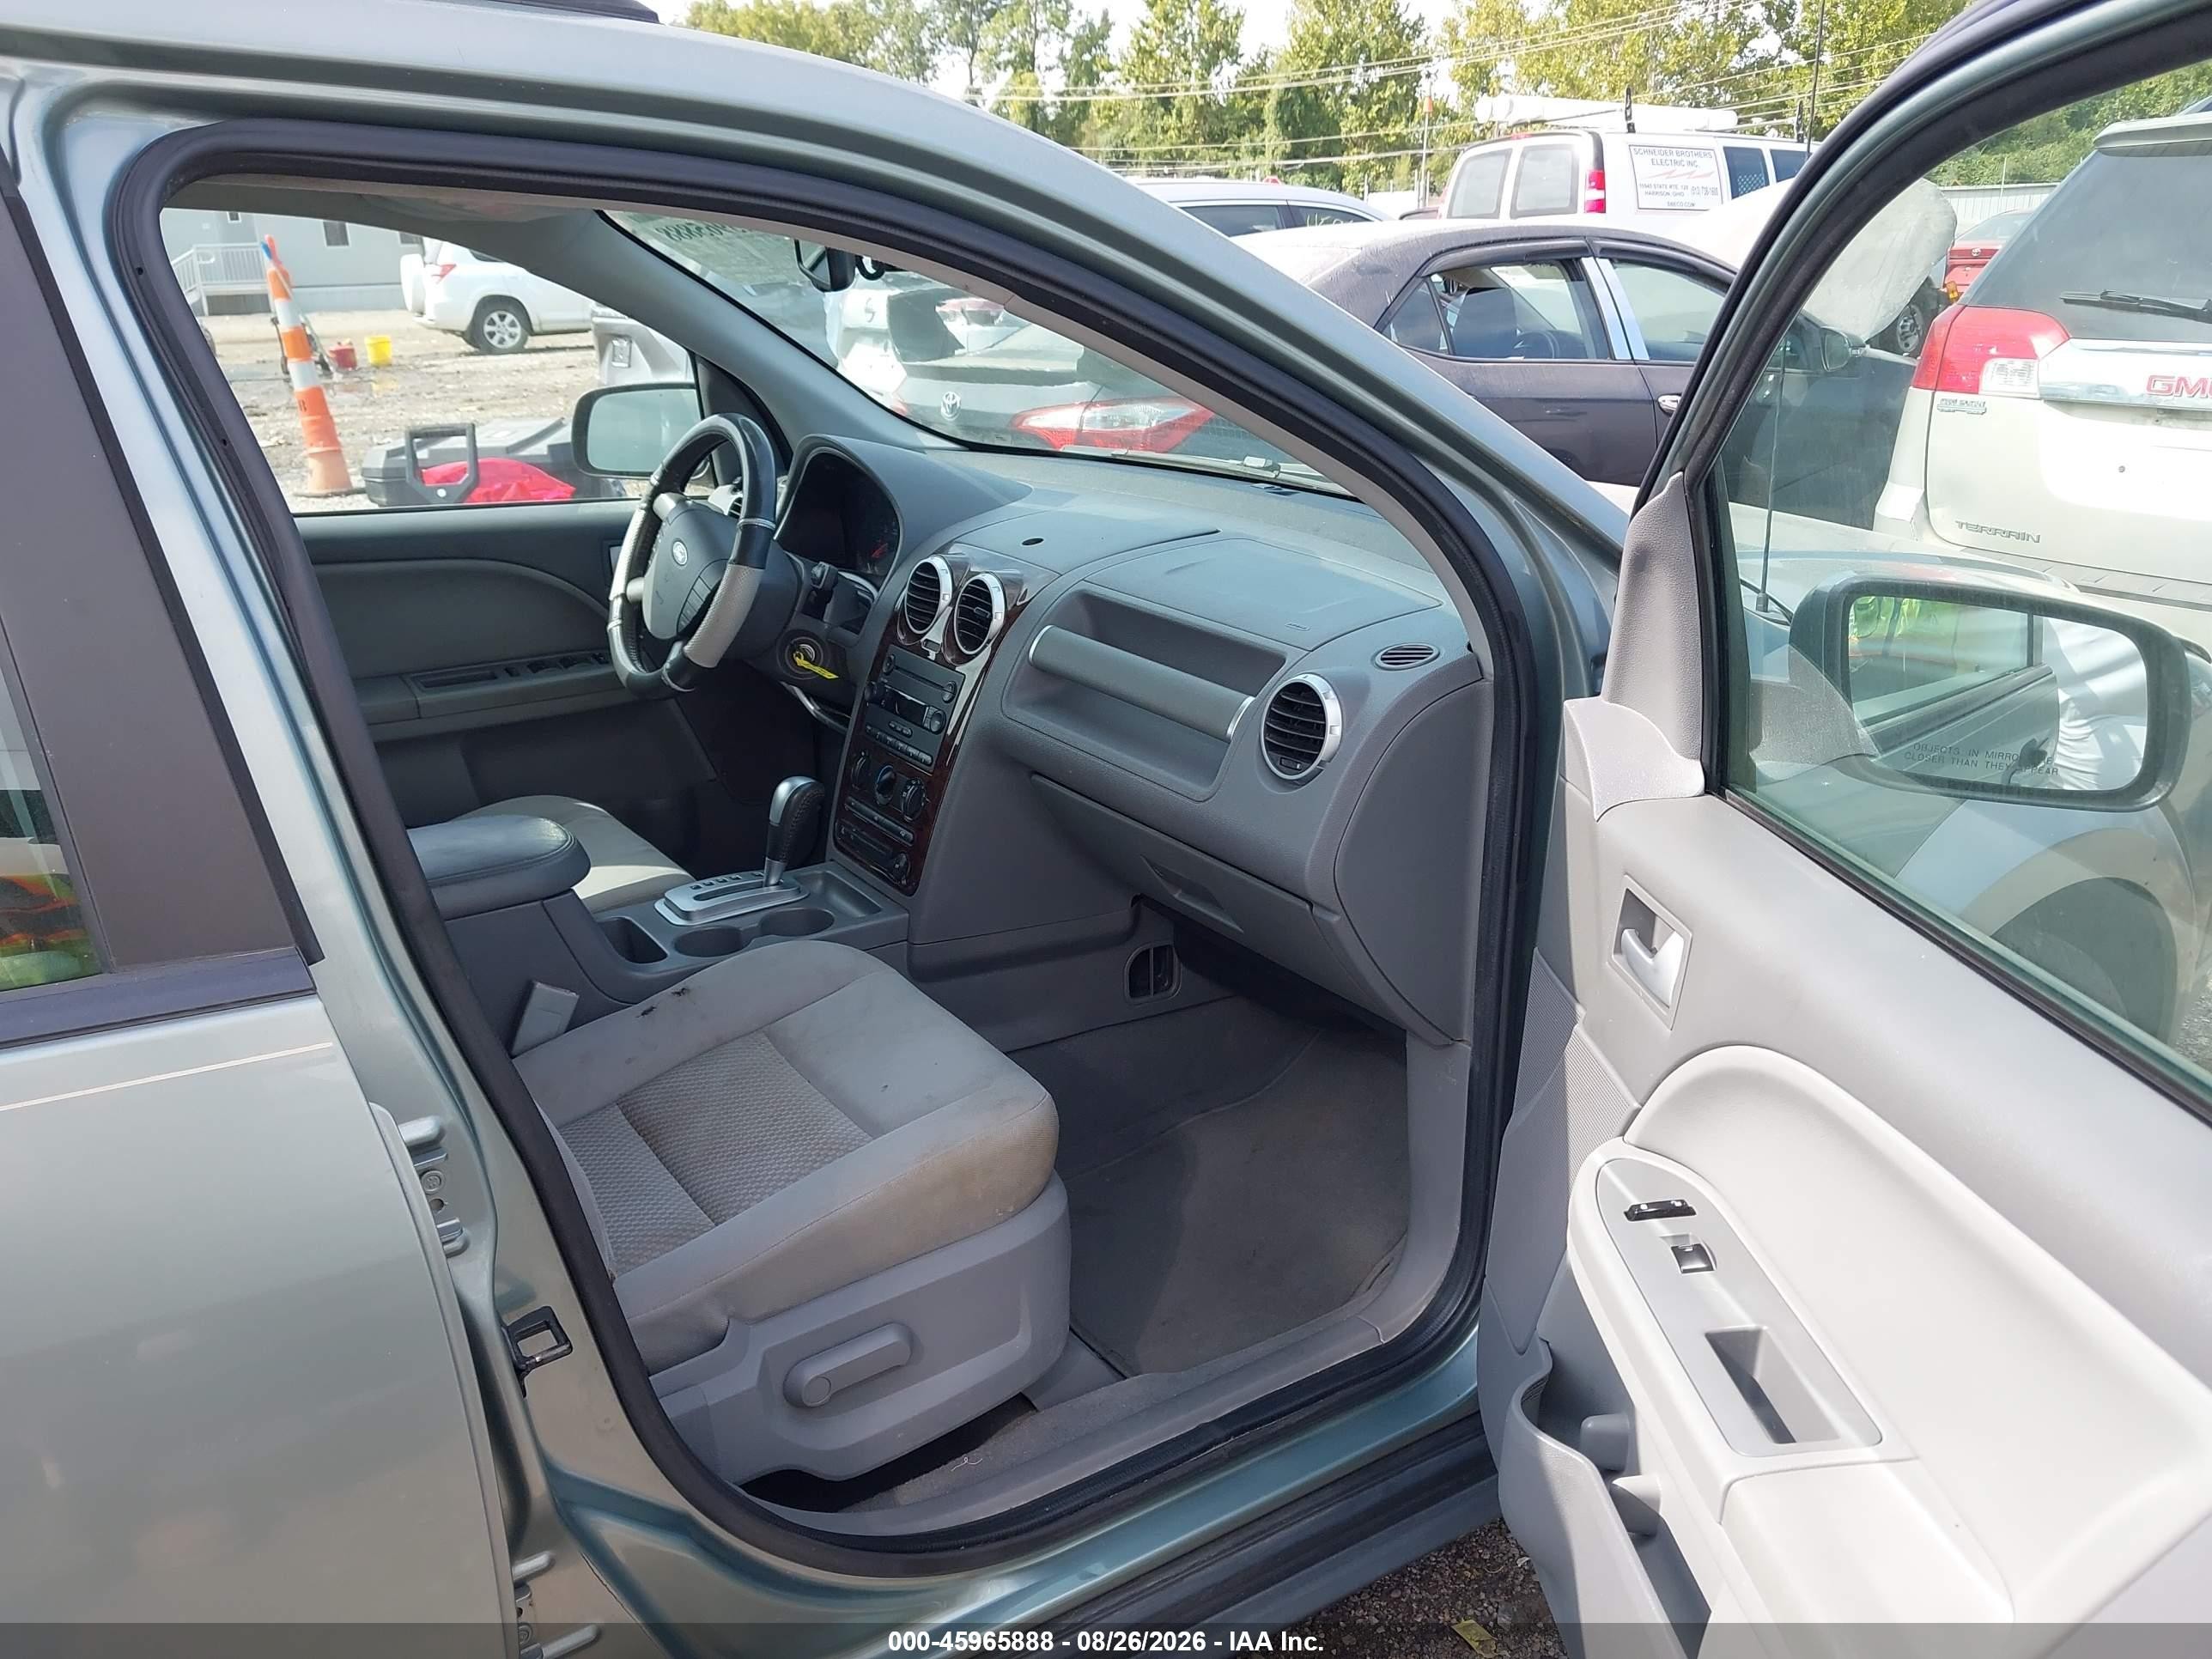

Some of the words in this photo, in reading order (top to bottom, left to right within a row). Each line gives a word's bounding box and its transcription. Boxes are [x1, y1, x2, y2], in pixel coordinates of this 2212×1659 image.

[1633, 148, 1674, 156] SCHNEIDER
[1675, 150, 1712, 159] BROTHERS
[1651, 158, 1685, 167] ELECTRIC
[2145, 374, 2212, 398] GM
[1954, 520, 2041, 544] TERRAIN
[1904, 751, 1945, 763] CLOSER
[1951, 757, 1978, 768] THAN
[1913, 742, 1960, 755] OBJECTS
[1968, 748, 1979, 759] IN
[1985, 750, 2020, 763] MIRRO
